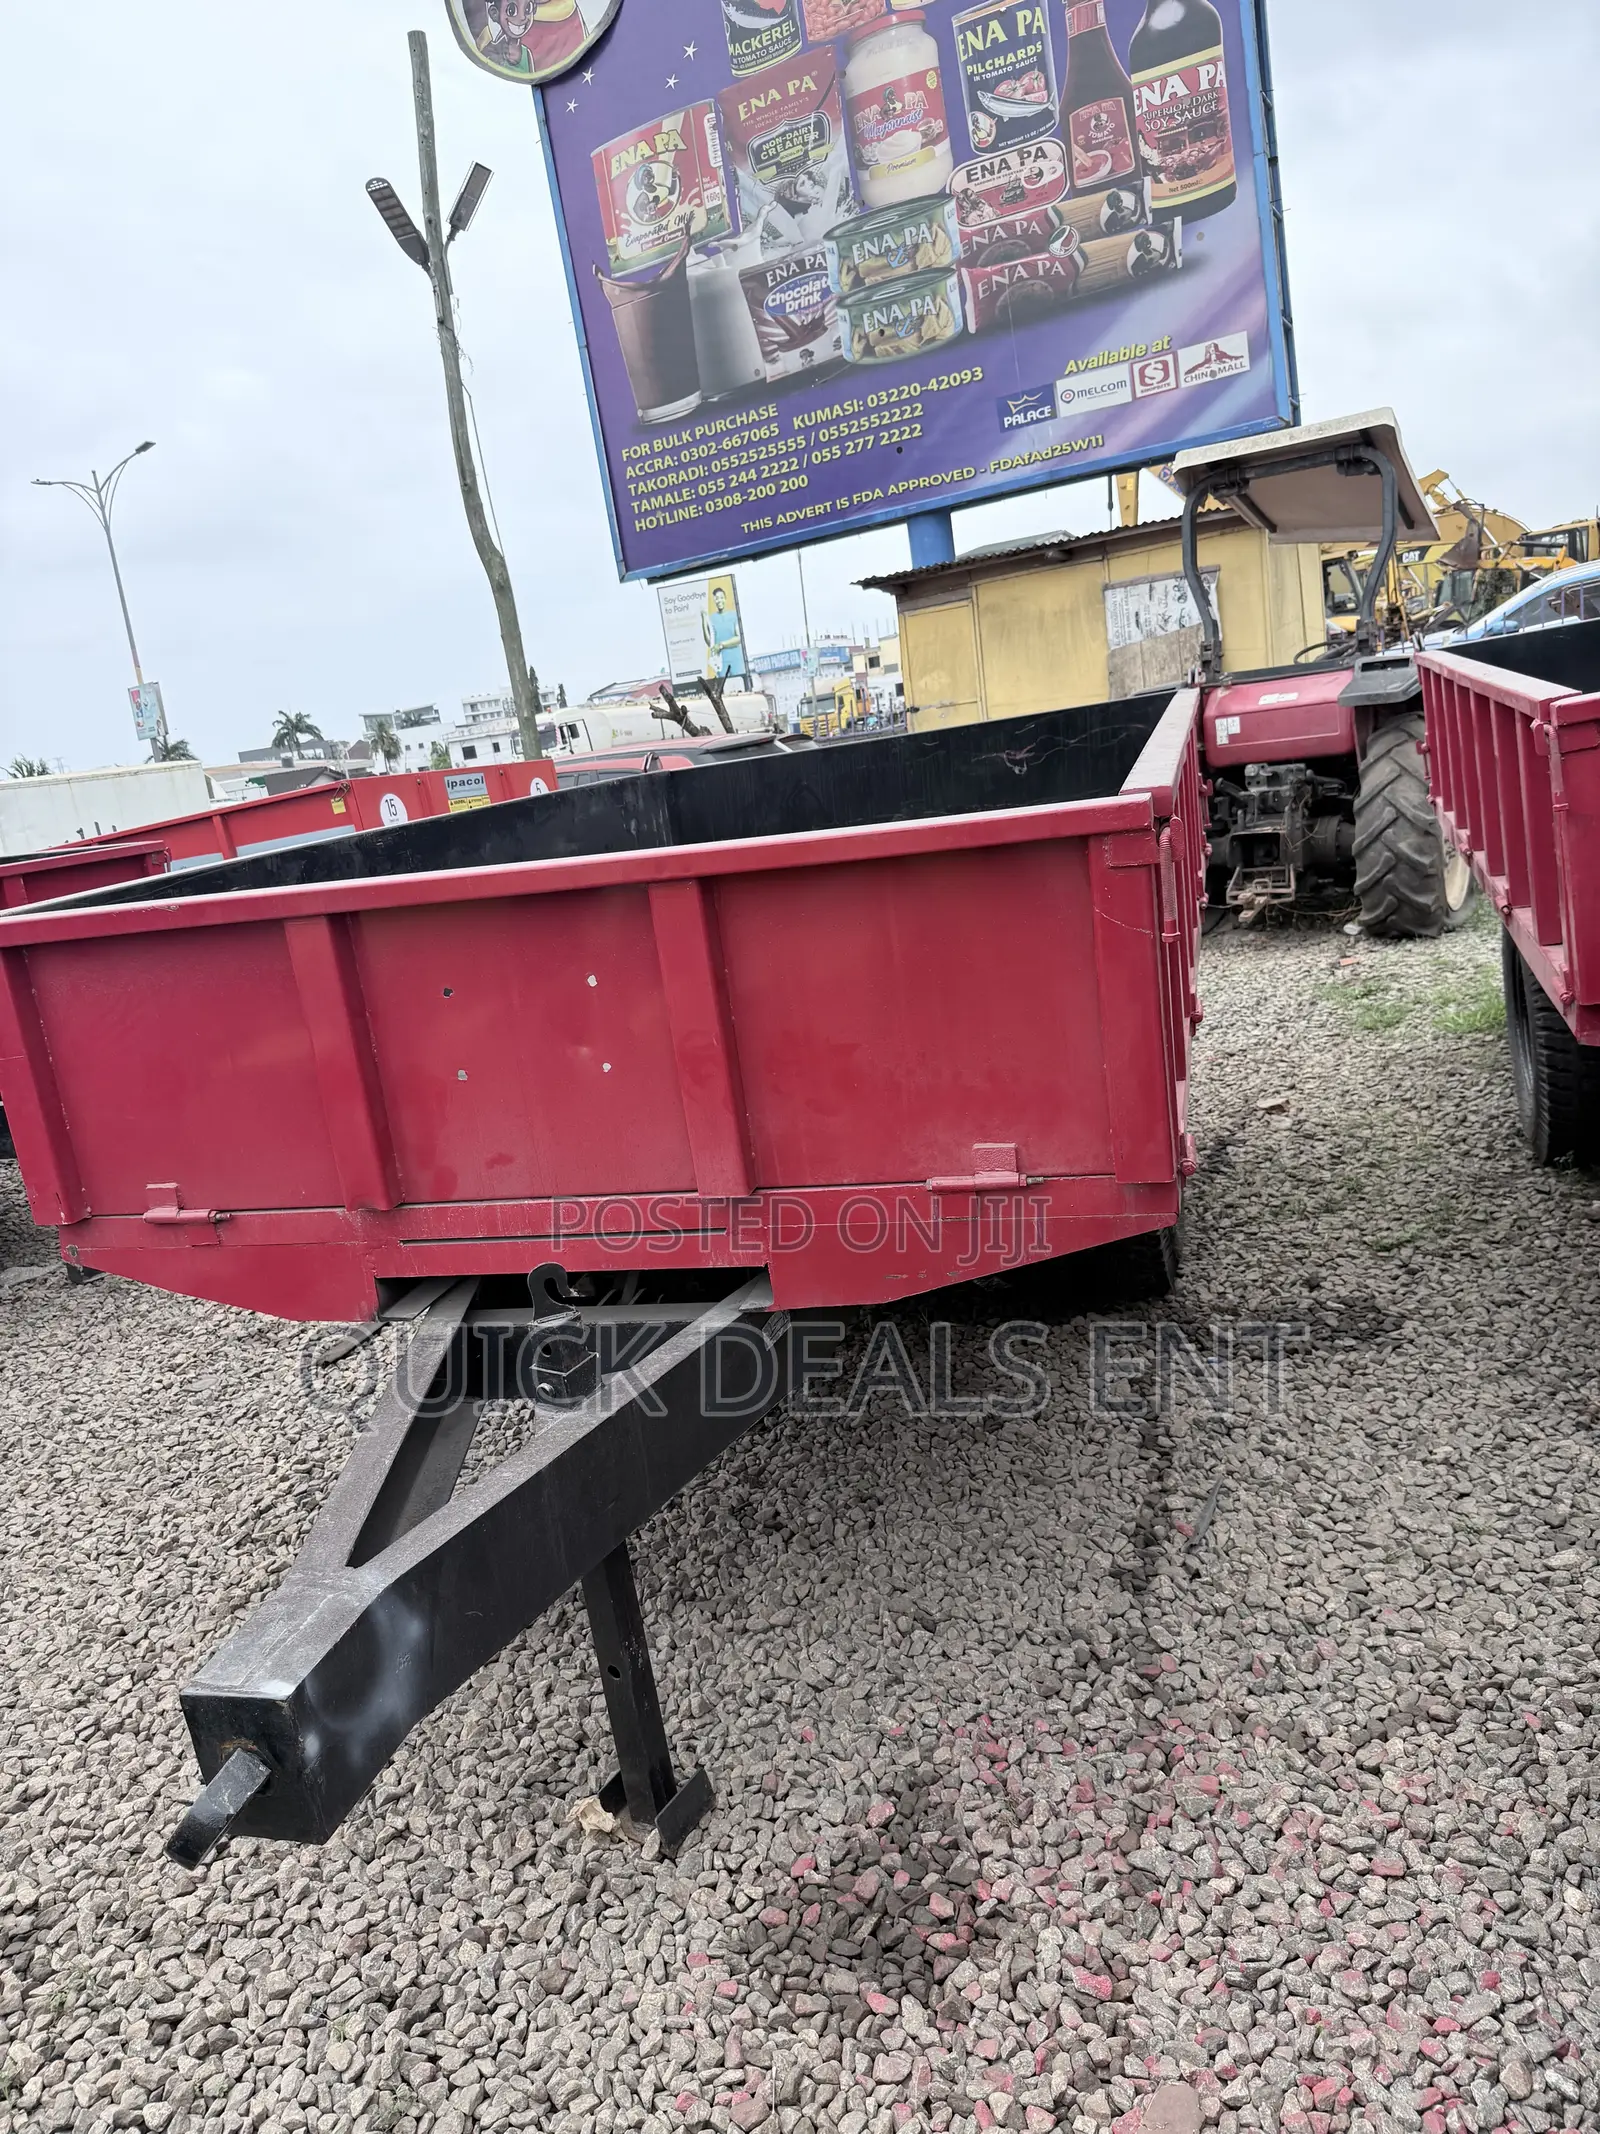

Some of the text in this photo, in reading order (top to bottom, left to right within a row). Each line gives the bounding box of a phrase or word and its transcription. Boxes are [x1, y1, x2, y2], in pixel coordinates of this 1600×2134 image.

[728, 20, 796, 56] MACKEREL
[738, 49, 767, 64] TOMATO
[768, 36, 792, 52] SAUCE
[957, 6, 1047, 62] ENA PA
[966, 40, 1043, 76] PILCHARDS
[982, 66, 1013, 80] TOMATO
[1015, 56, 1037, 69] SAUCE
[737, 75, 818, 121] ENA PA
[1133, 60, 1226, 117] ENA PA
[1192, 91, 1219, 106] DARK
[854, 90, 929, 134] ENA PA
[1079, 101, 1117, 121] ENA PA
[1145, 99, 1218, 132] SOY SAUCE
[760, 131, 820, 160] CREAMER
[762, 124, 815, 151] NON-DAIRY
[1088, 122, 1116, 139] TOMATO
[610, 129, 688, 180] ENA PA
[886, 156, 917, 174] Premium
[966, 146, 1048, 184] ENA PA
[625, 219, 670, 248] Evaporated
[852, 233, 897, 266] ENA
[903, 223, 933, 245] PA
[960, 219, 1043, 260] ENA PA
[765, 262, 800, 288] ENA
[804, 253, 828, 269] PA
[977, 260, 1066, 300] ENA PA
[767, 275, 828, 307] Chocolat
[785, 291, 822, 314] Drink
[861, 295, 937, 334] ENA PA
[1064, 335, 1171, 376] Available at
[1218, 361, 1247, 374] MALL
[793, 366, 984, 430] KUMASI: 03220-42093
[621, 405, 779, 462] FOR BULK PURCHASE
[1003, 405, 1052, 428] PALACE
[625, 423, 780, 480] ACCRA: 0302-667065
[627, 402, 924, 497] TAKORADI: 0552525555 / 0552552222
[631, 423, 923, 515] TAMALE: 055 244 2222 / 055 277 2222
[741, 517, 774, 534] THIS
[776, 500, 833, 526] ADVERT
[836, 497, 850, 510] IS
[852, 488, 884, 505] FDA
[887, 466, 976, 496] APPROVED
[989, 434, 1104, 473] FDAfAd25W11
[634, 474, 809, 532] HOTLINE: 0308-200 200
[1402, 550, 1421, 564] CAT
[385, 798, 398, 817] 15
